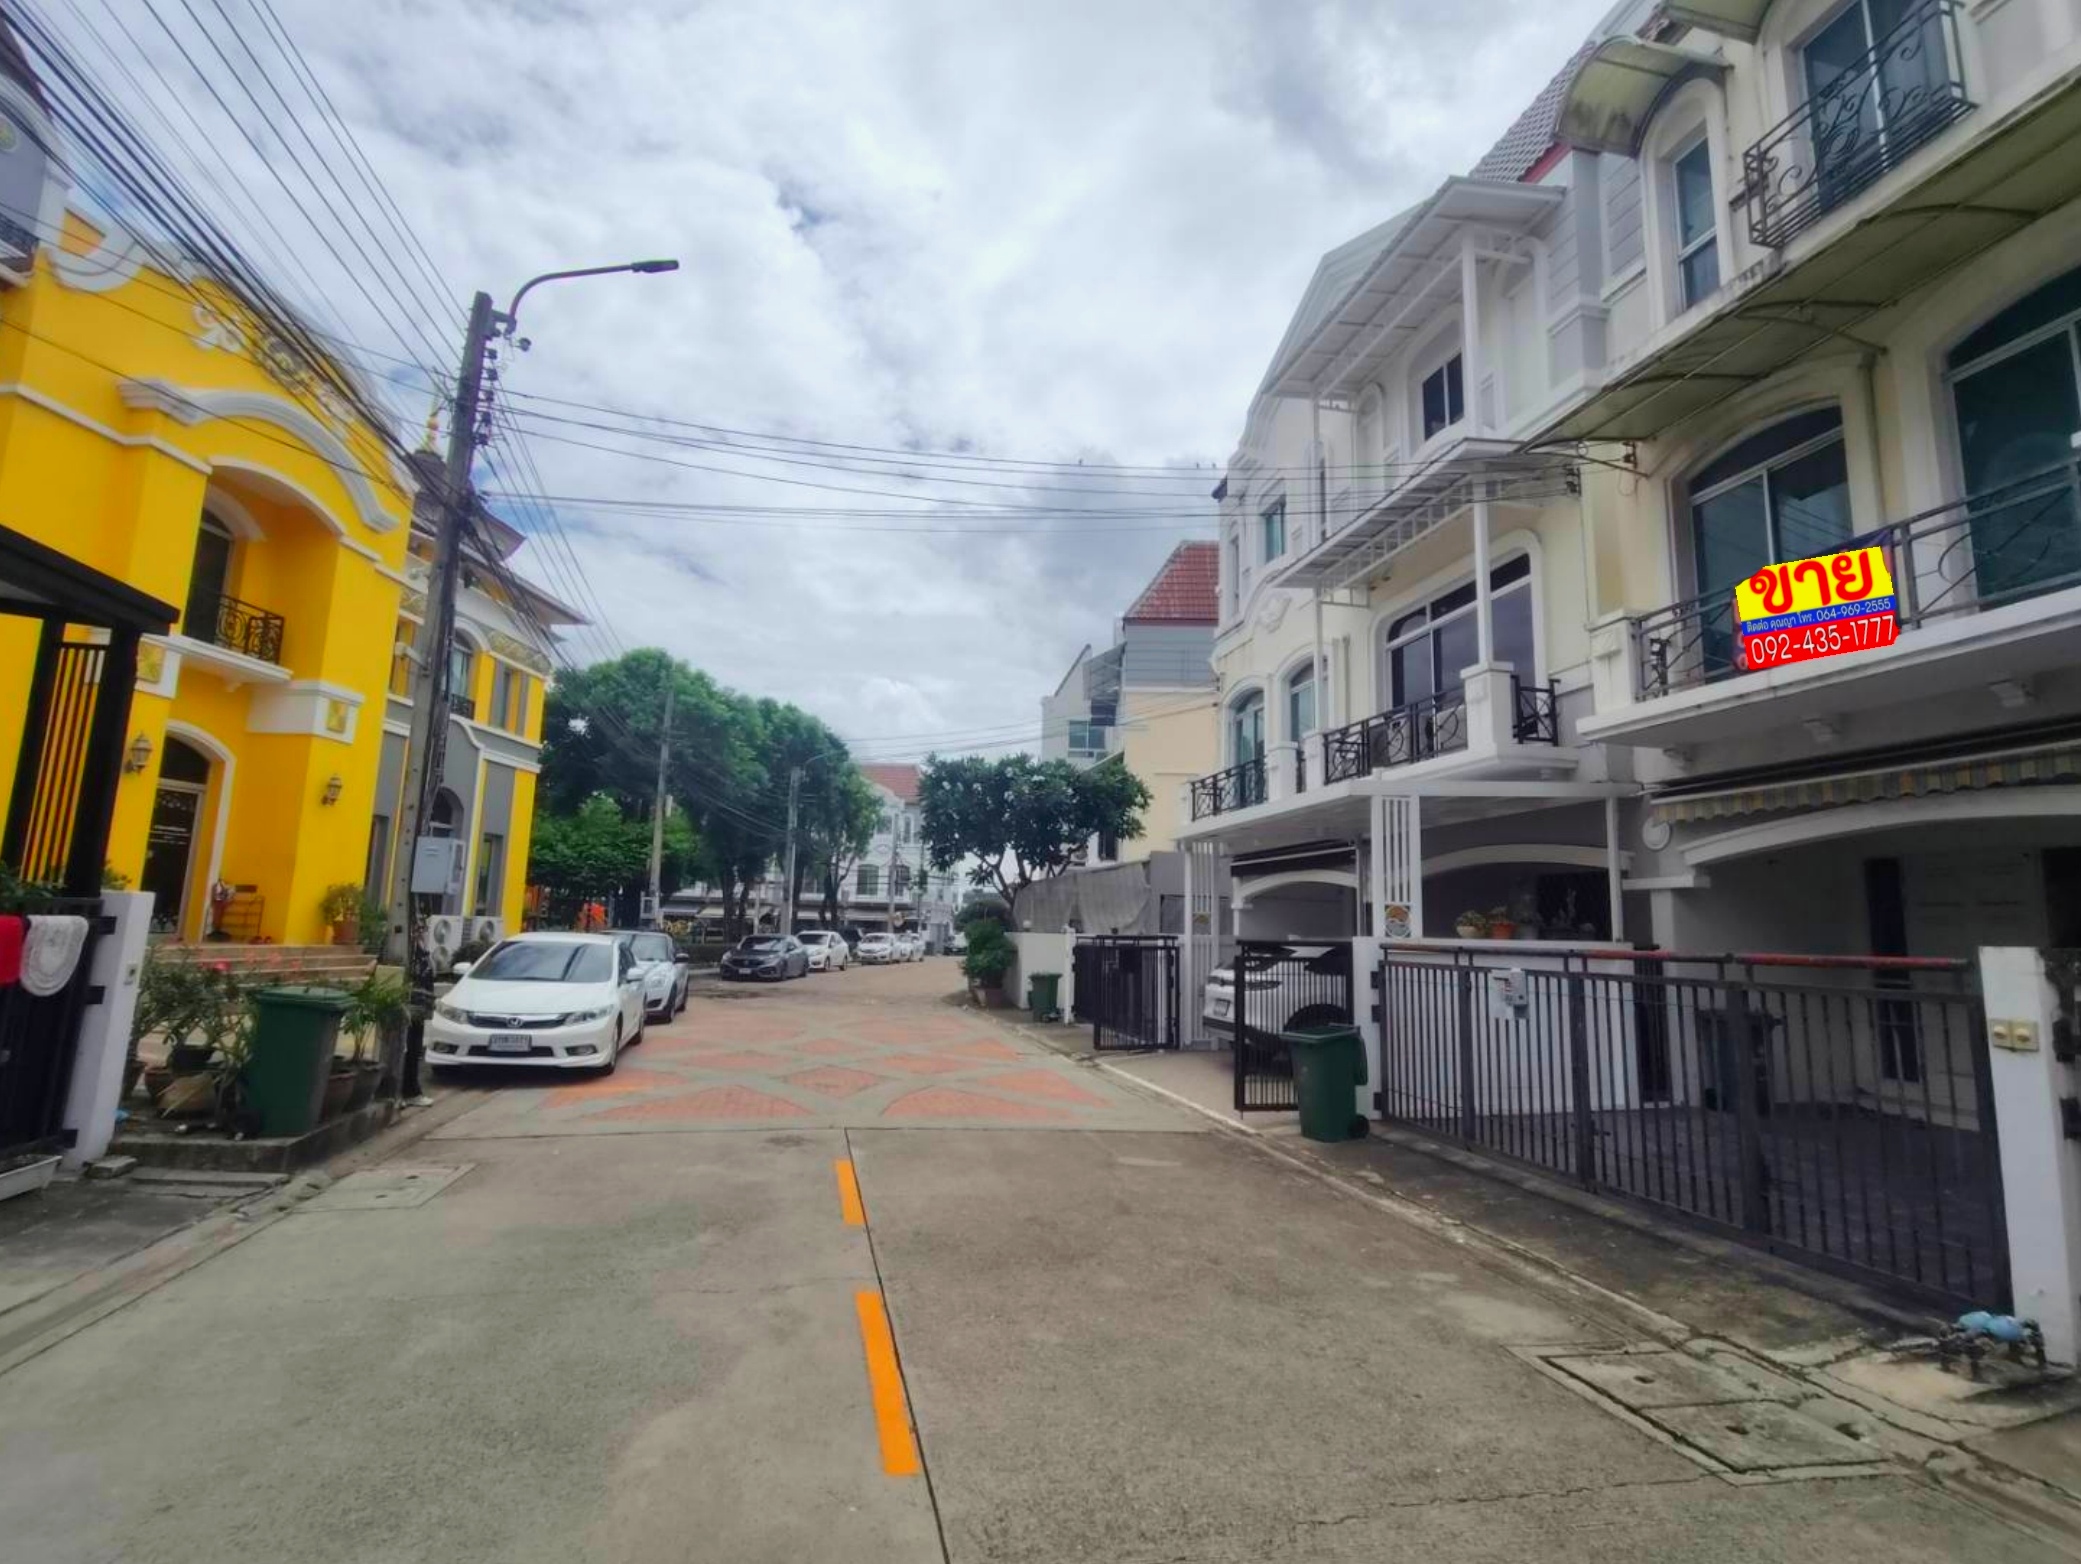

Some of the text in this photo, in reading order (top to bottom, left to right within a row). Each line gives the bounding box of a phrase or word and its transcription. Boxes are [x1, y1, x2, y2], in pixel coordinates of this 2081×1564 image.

[1749, 550, 1873, 614] ขาย
[1816, 598, 1891, 621] 064-969-2555
[1751, 615, 1894, 664] 092-435-1777
